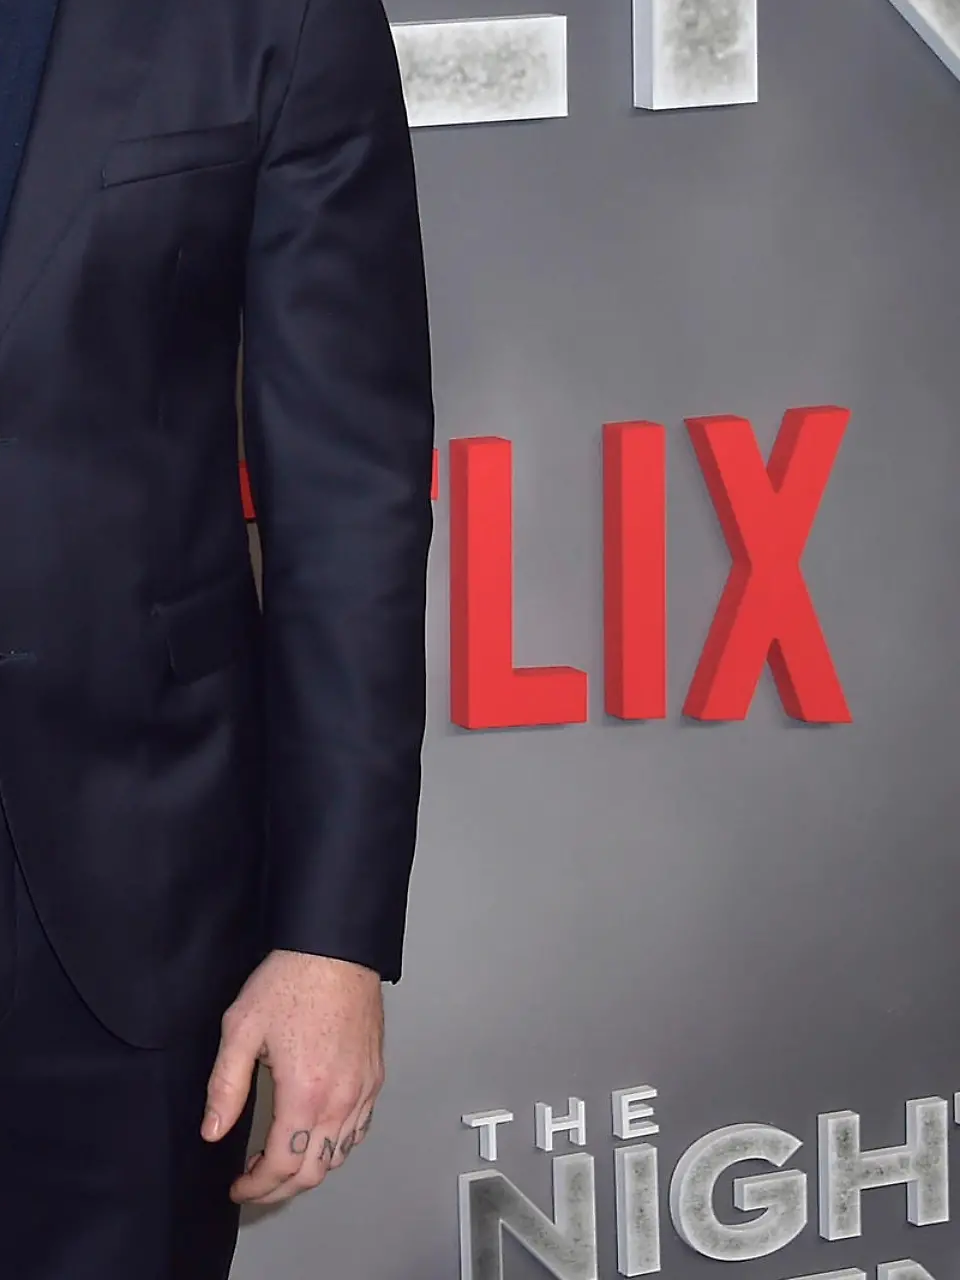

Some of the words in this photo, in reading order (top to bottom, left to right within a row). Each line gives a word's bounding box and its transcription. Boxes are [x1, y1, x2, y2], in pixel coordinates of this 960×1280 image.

[431, 405, 852, 730] LIX
[458, 1091, 960, 1280] NIGH
[460, 1085, 659, 1161] THE
